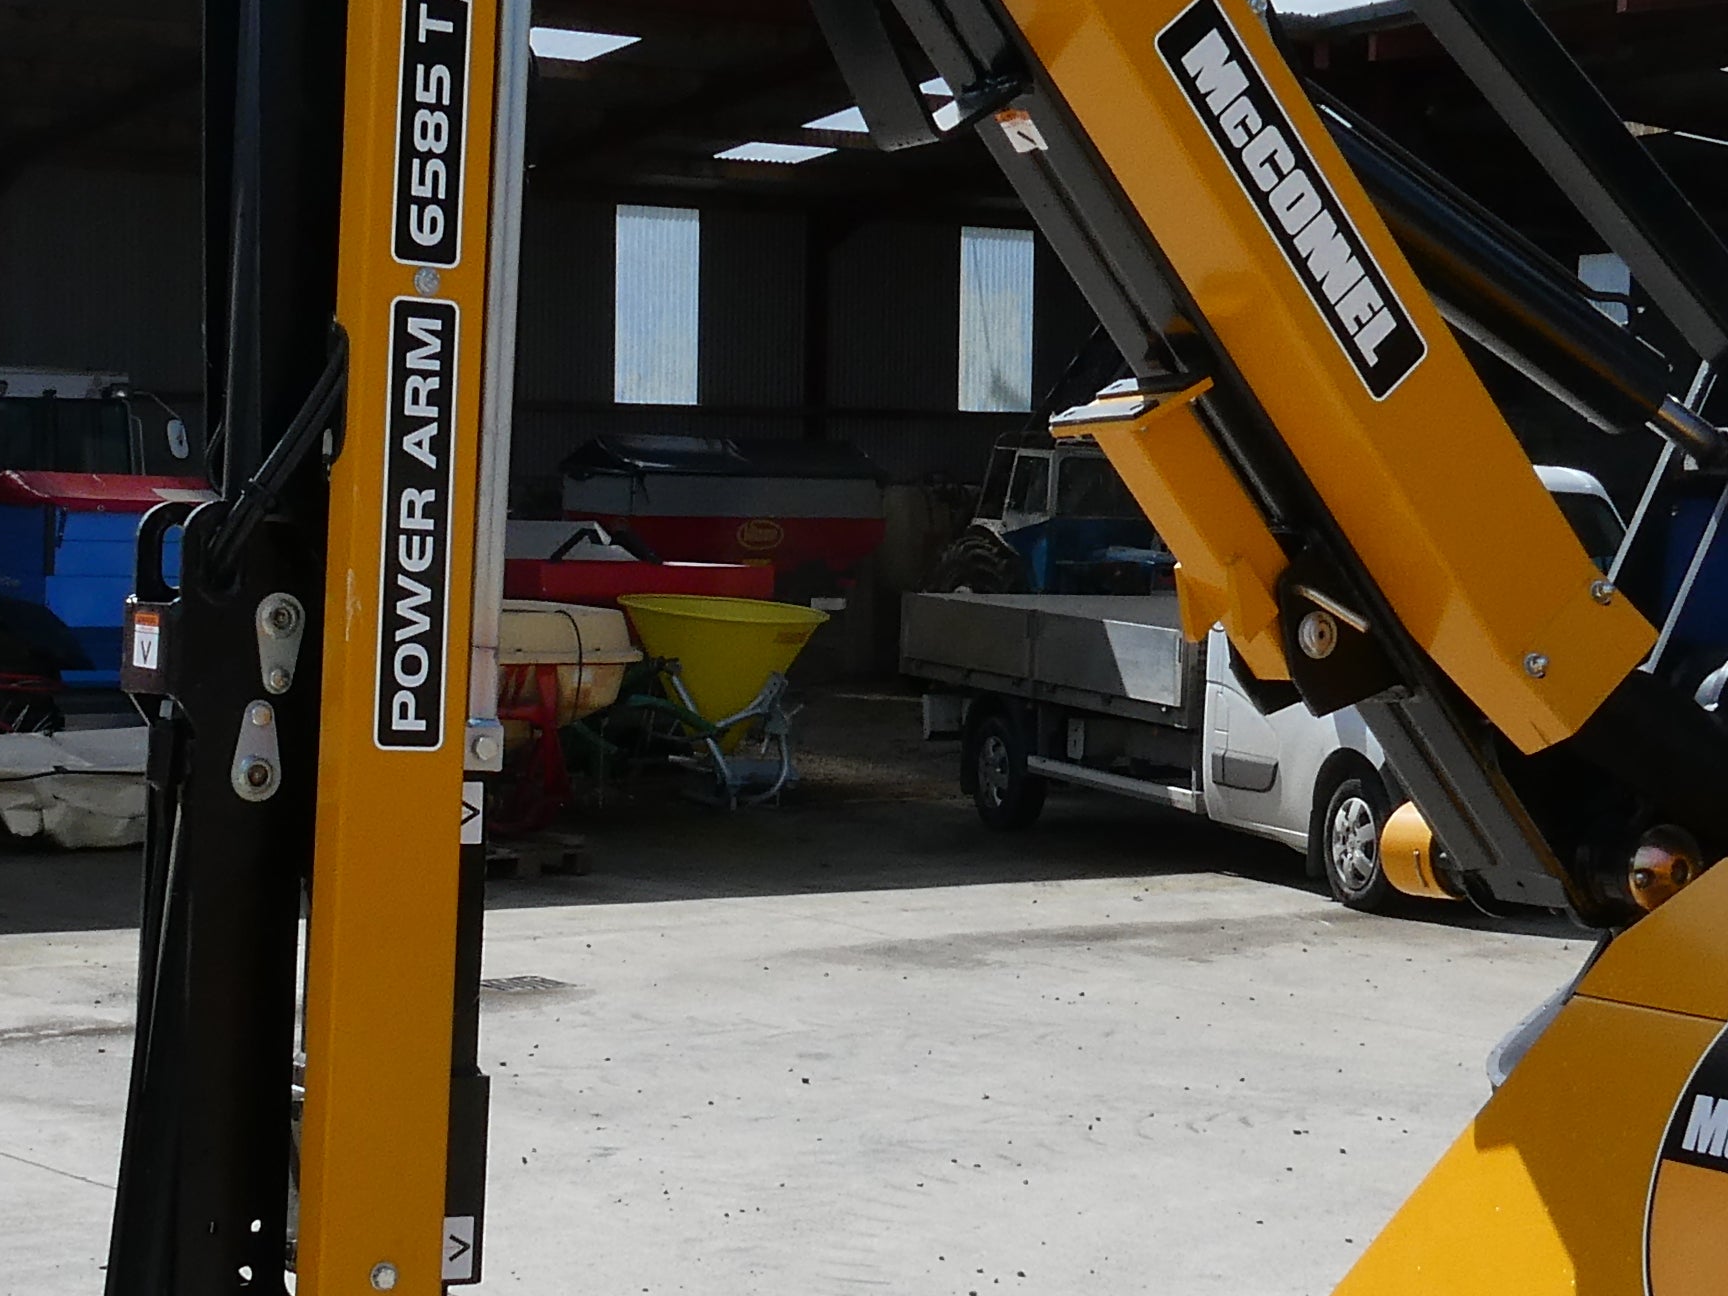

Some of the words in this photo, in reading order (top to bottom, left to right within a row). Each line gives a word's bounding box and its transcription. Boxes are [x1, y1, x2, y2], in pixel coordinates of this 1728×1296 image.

[418, 3, 454, 43] T
[409, 63, 452, 247] 6585
[402, 315, 443, 471] ARM
[390, 486, 437, 732] POWER
